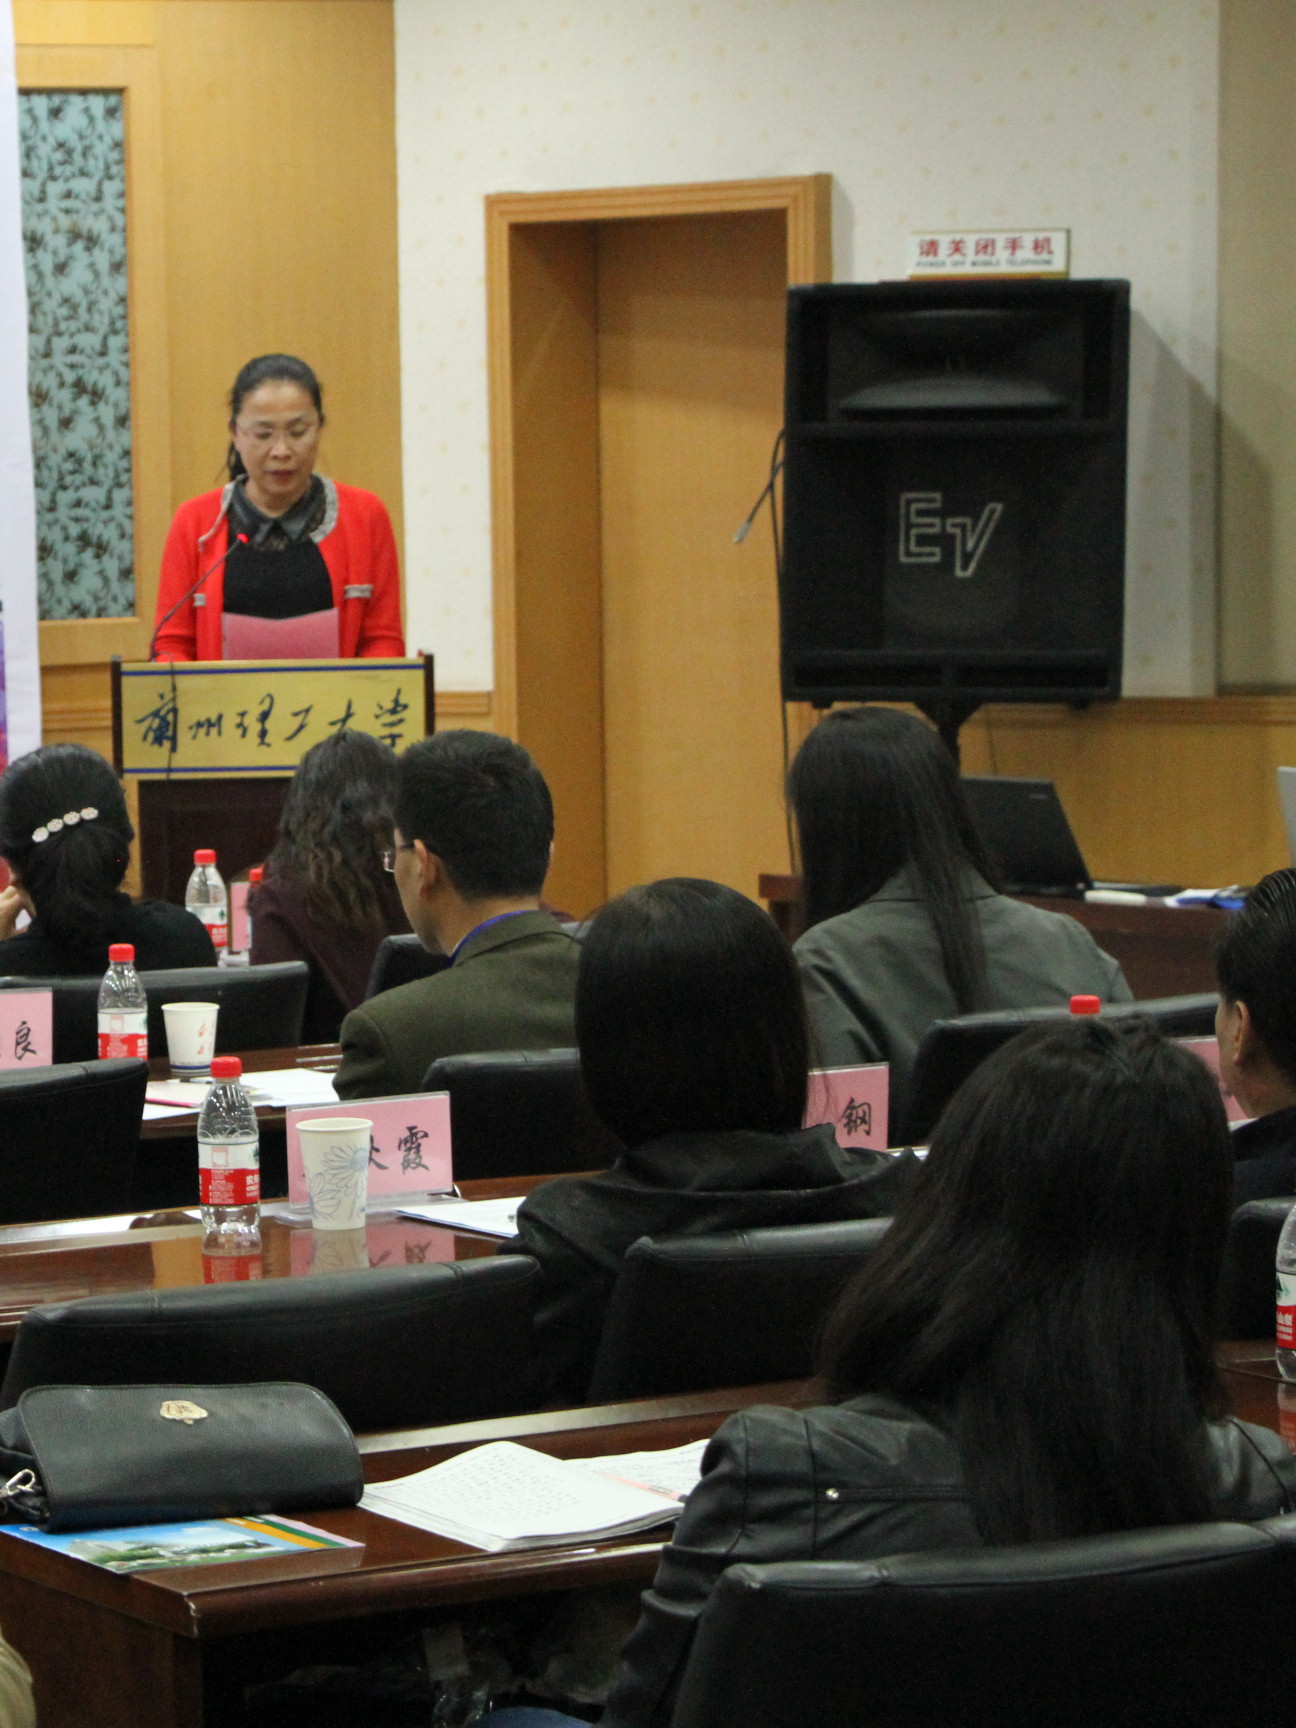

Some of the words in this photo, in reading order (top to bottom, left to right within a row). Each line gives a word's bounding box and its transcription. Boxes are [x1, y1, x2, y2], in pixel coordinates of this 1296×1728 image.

[918, 236, 1054, 258] 请关闭手机
